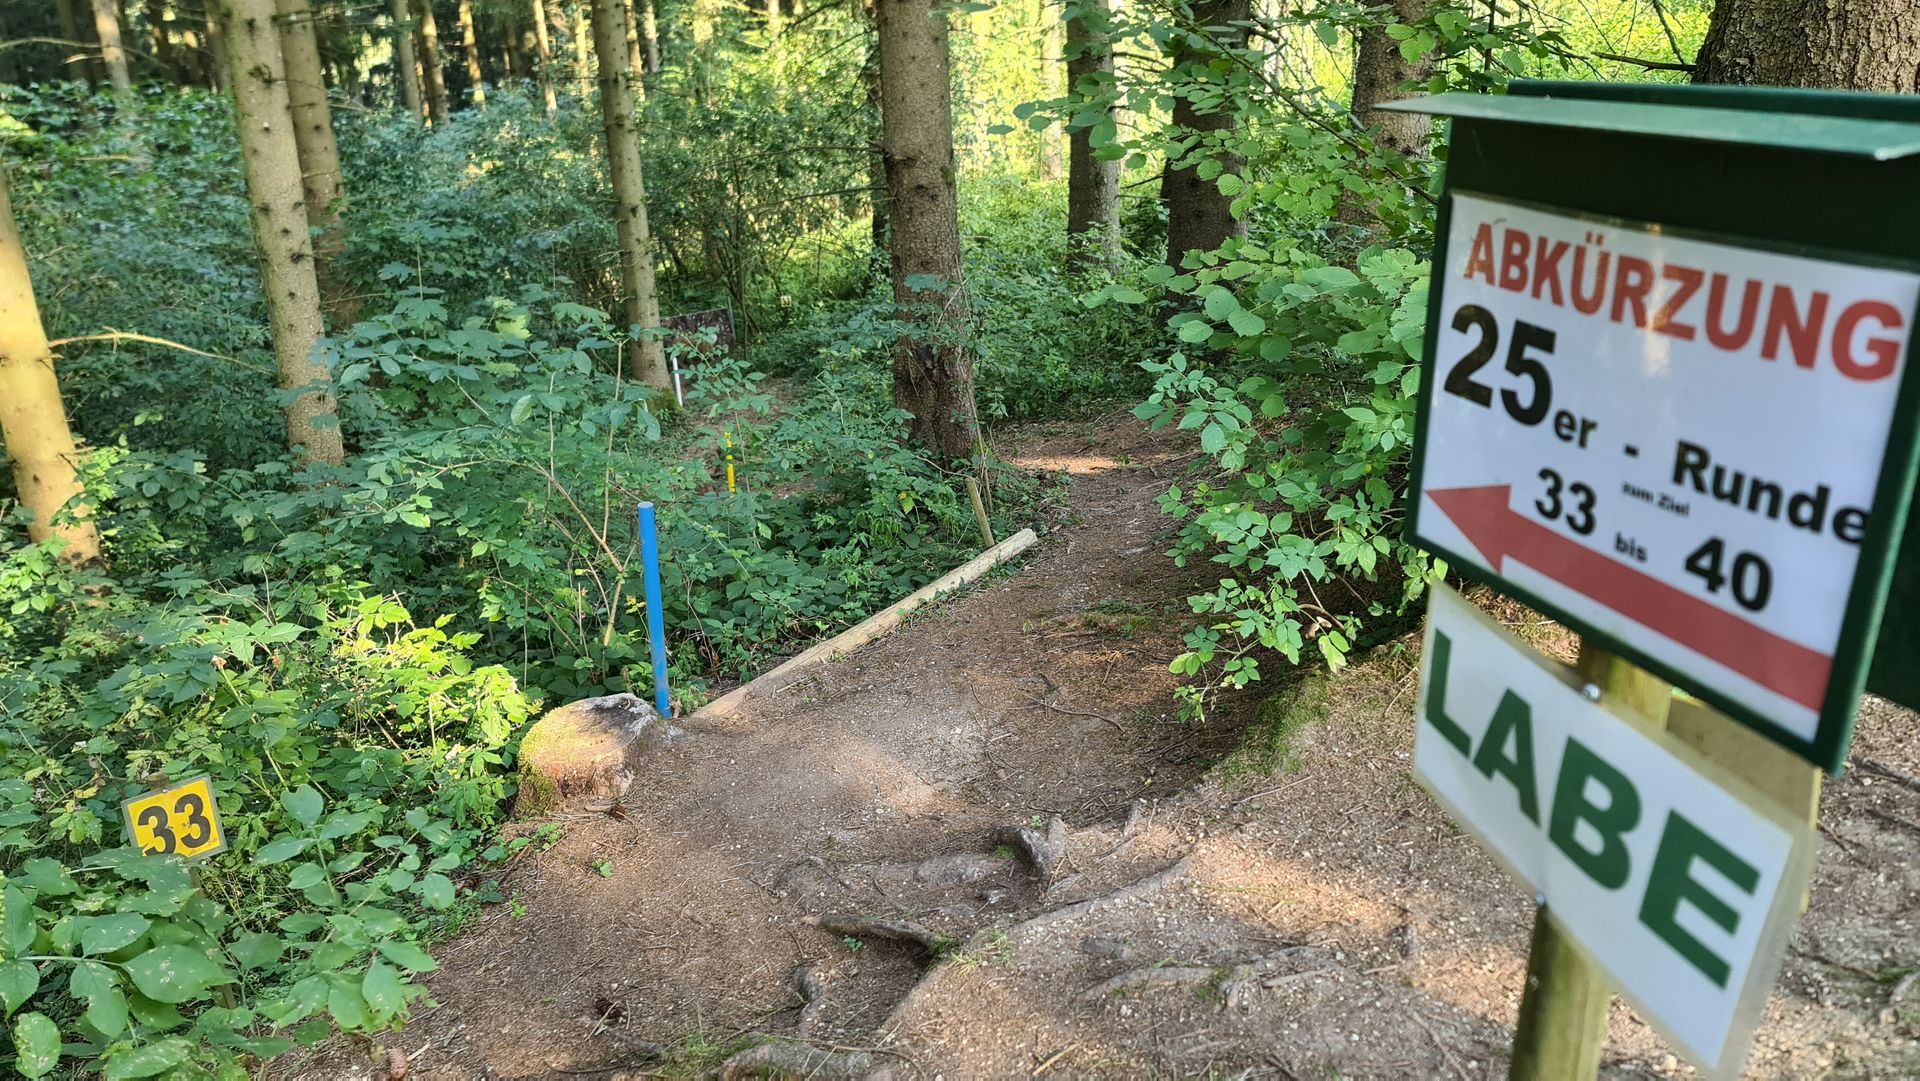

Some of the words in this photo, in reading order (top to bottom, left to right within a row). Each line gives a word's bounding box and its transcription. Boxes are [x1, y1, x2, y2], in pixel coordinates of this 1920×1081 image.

[1464, 222, 1905, 383] ABKÜRZUNG
[1443, 304, 1597, 449] 25er
[1672, 440, 1870, 545] Runde
[1622, 482, 1654, 504] zum
[1534, 468, 1597, 536] 33
[1614, 533, 1648, 563] bis
[1684, 537, 1773, 613] 40
[138, 793, 211, 855] 33
[1425, 628, 1762, 989] LABE
